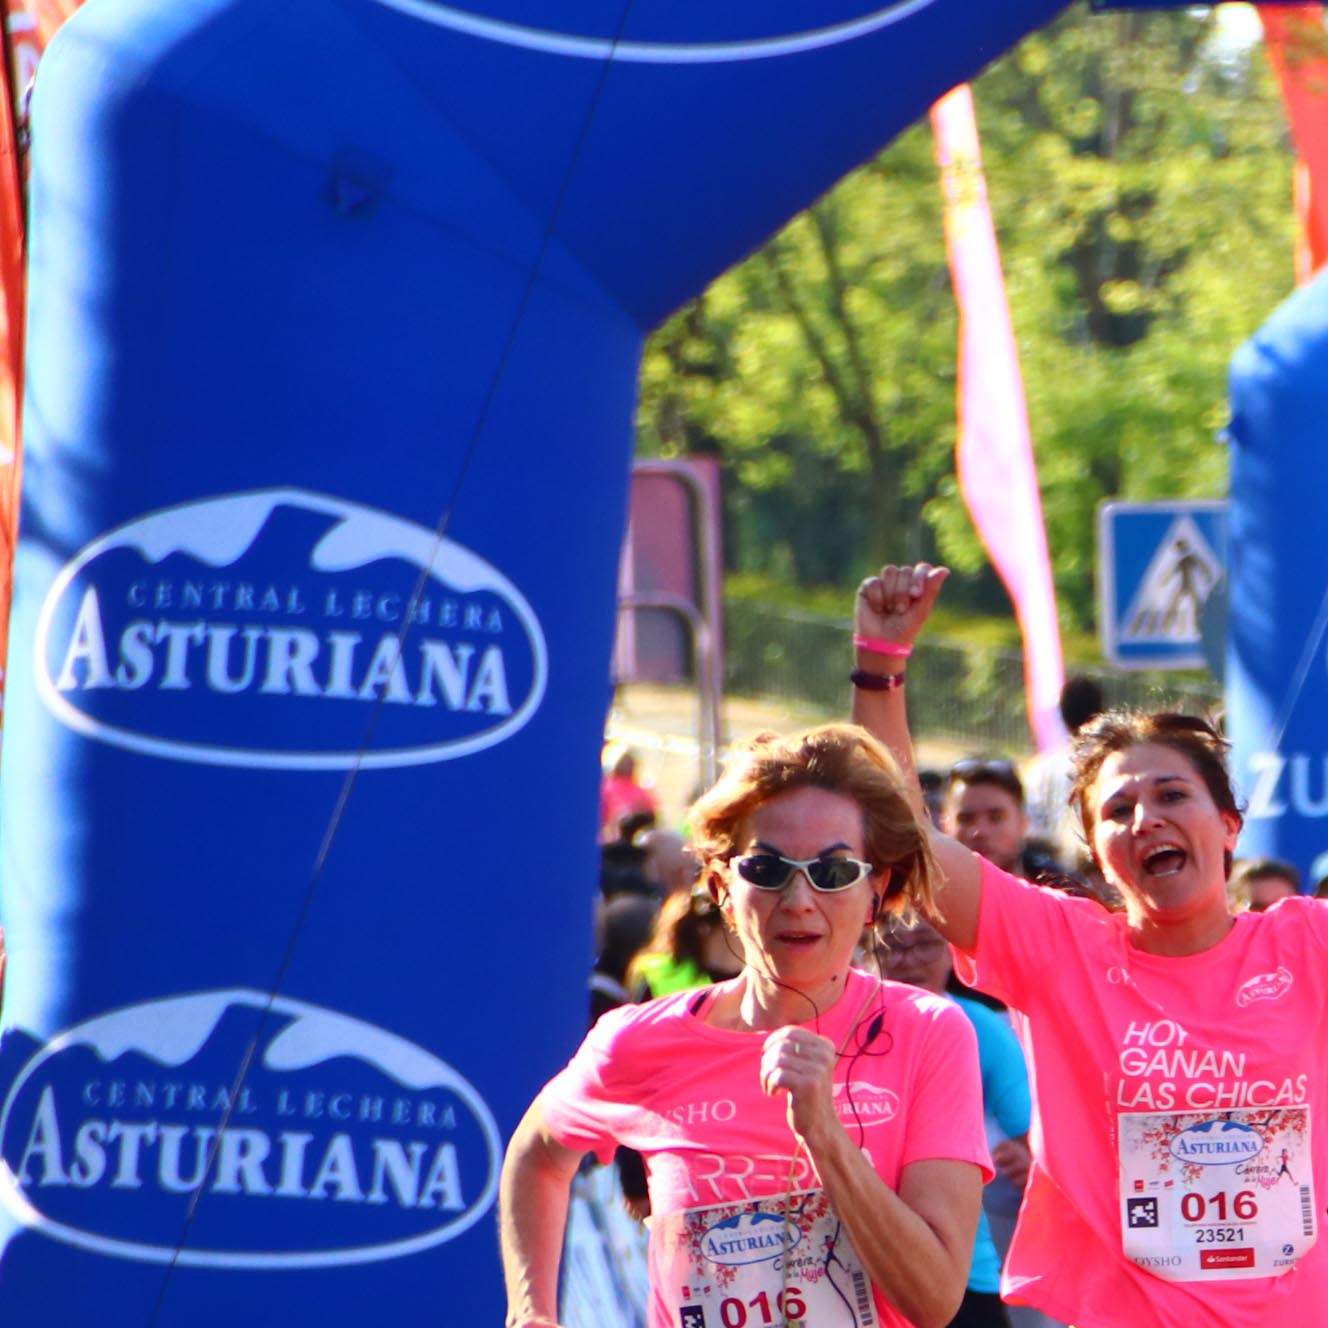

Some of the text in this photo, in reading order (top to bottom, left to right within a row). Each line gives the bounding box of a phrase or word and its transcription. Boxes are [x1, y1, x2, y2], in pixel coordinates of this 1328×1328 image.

[127, 580, 503, 634] CENTRAL LECHERA
[56, 585, 513, 715] ASTURIANA
[1122, 1019, 1189, 1047] HOY
[1119, 1047, 1246, 1079] GANAN
[83, 1079, 458, 1130] CENTRAL LECHERA
[1117, 1073, 1308, 1109] LAS CHICAS
[18, 1085, 467, 1211] ASTURIANA
[1177, 1139, 1258, 1155] ASTURIANA
[1180, 1190, 1259, 1222] 016
[706, 1231, 795, 1257] ASTURIANA
[1195, 1228, 1244, 1244] 23521
